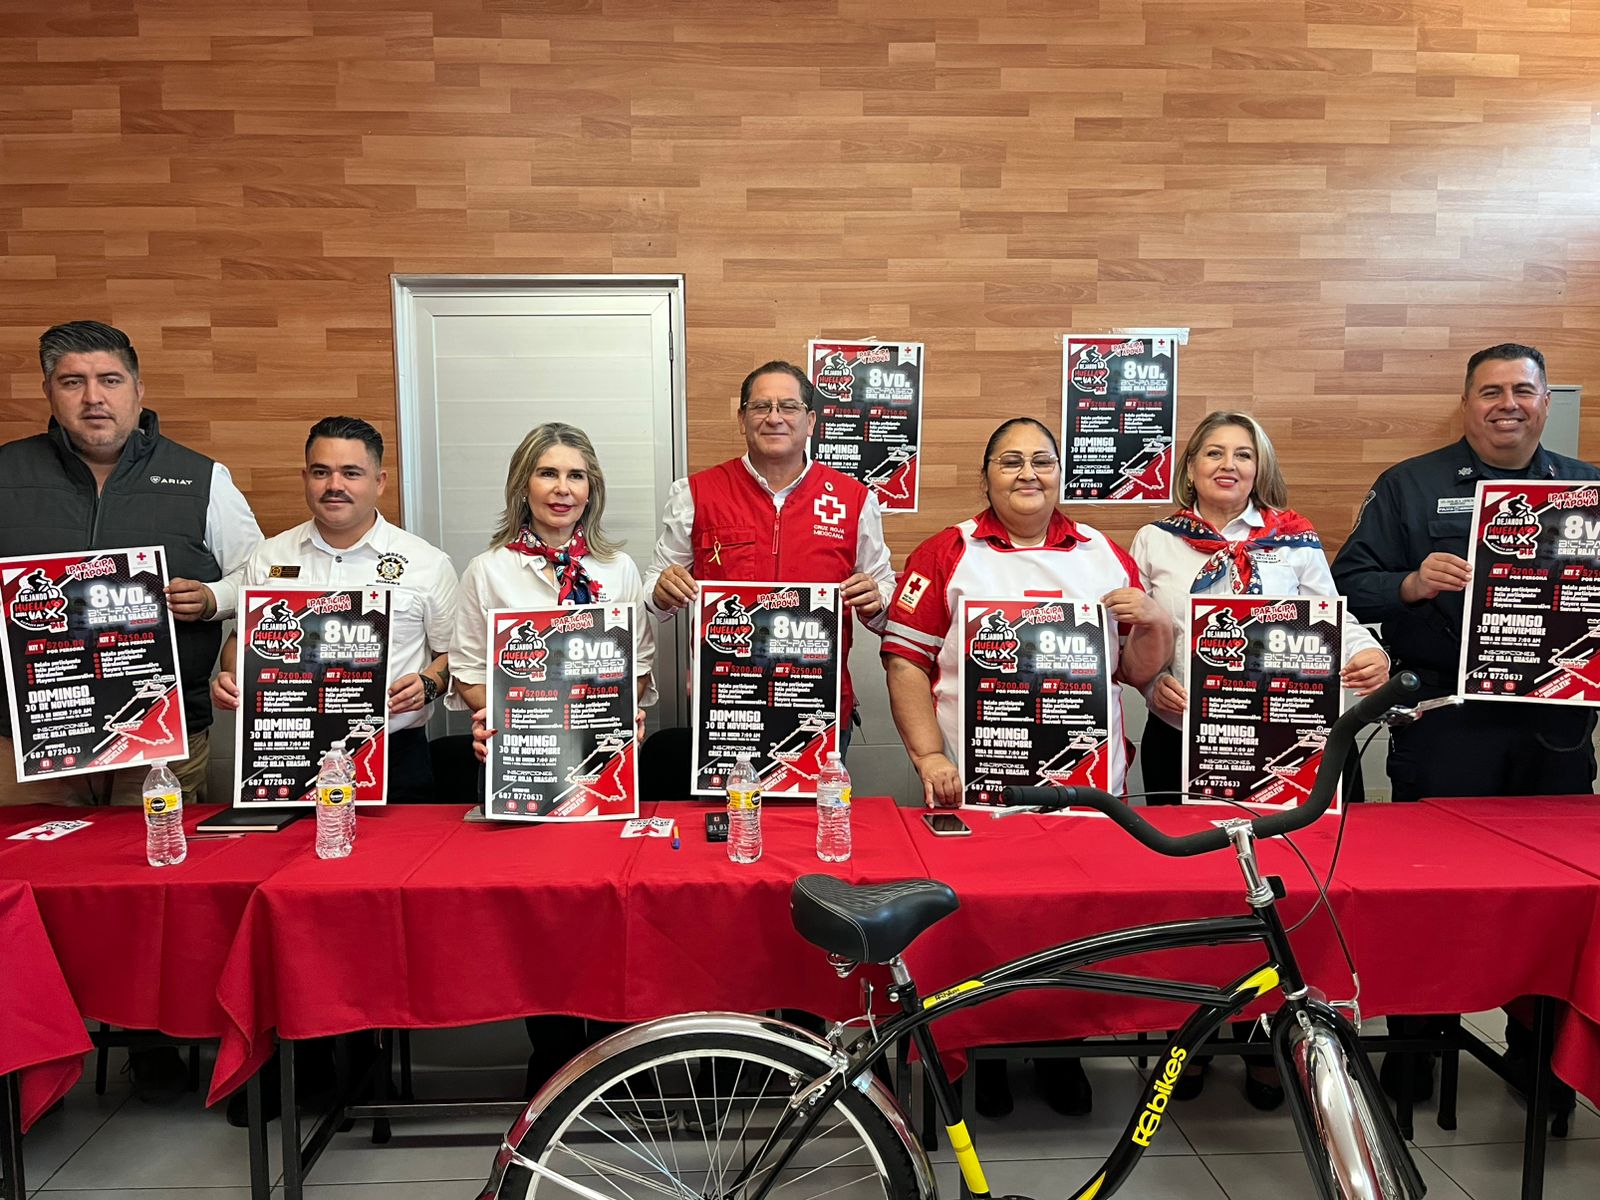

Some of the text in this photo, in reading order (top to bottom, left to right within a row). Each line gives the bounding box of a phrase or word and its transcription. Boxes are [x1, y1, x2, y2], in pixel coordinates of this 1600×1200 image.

[814, 530, 844, 540] MEXICANA
[830, 526, 845, 534] ROJA
[20, 592, 48, 601] DEJANDO
[13, 600, 52, 612] HUELLA
[88, 616, 107, 624] CRUZ
[108, 614, 124, 622] ROJA
[1481, 612, 1543, 628] DOMINGO
[255, 631, 288, 639] HUELLA
[710, 625, 740, 634] HUELLA
[1476, 625, 1546, 636] 30 DE NOVIEMBRE
[974, 641, 1005, 649] HUELLA
[503, 650, 534, 659] HUELLA
[26, 685, 91, 704] DOMINGO
[24, 696, 96, 713] 30 DE NOVIEMBRE
[709, 709, 761, 724] DOMINGO
[254, 718, 310, 731] DOMINGO
[705, 721, 764, 731] 30 DE NOVIEMBRE
[250, 730, 314, 739] 30 DE NOVIEMBRE
[975, 726, 1028, 741] DOMINGO
[1199, 722, 1255, 739] DOMINGO
[503, 735, 556, 747] DOMINGO
[971, 738, 1032, 749] 30 DE NOVIEMBRE
[1195, 735, 1258, 747] 30 DE NOVIEMBRE
[499, 746, 509, 754] 30
[521, 746, 560, 755] NOVIEMBRE
